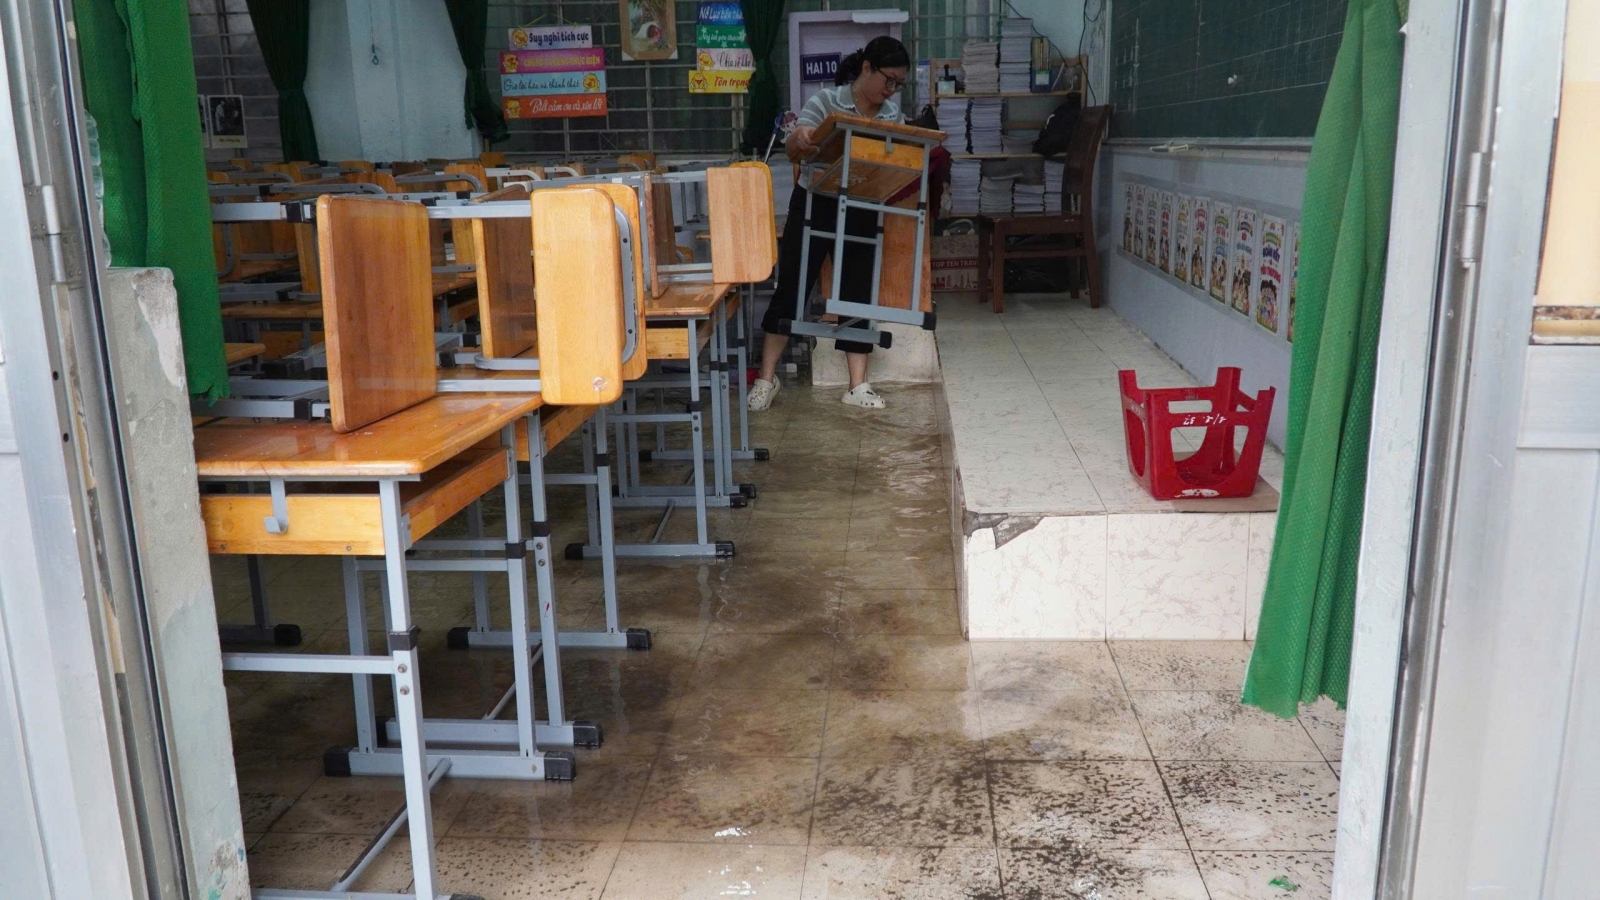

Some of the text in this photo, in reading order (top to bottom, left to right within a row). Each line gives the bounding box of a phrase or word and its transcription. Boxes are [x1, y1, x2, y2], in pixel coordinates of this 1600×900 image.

[529, 33, 542, 46] Suy
[560, 31, 575, 42] tích
[577, 32, 589, 43] cực
[806, 61, 837, 75] HAI 10
[567, 77, 580, 88] thật
[714, 76, 727, 86] Tôn
